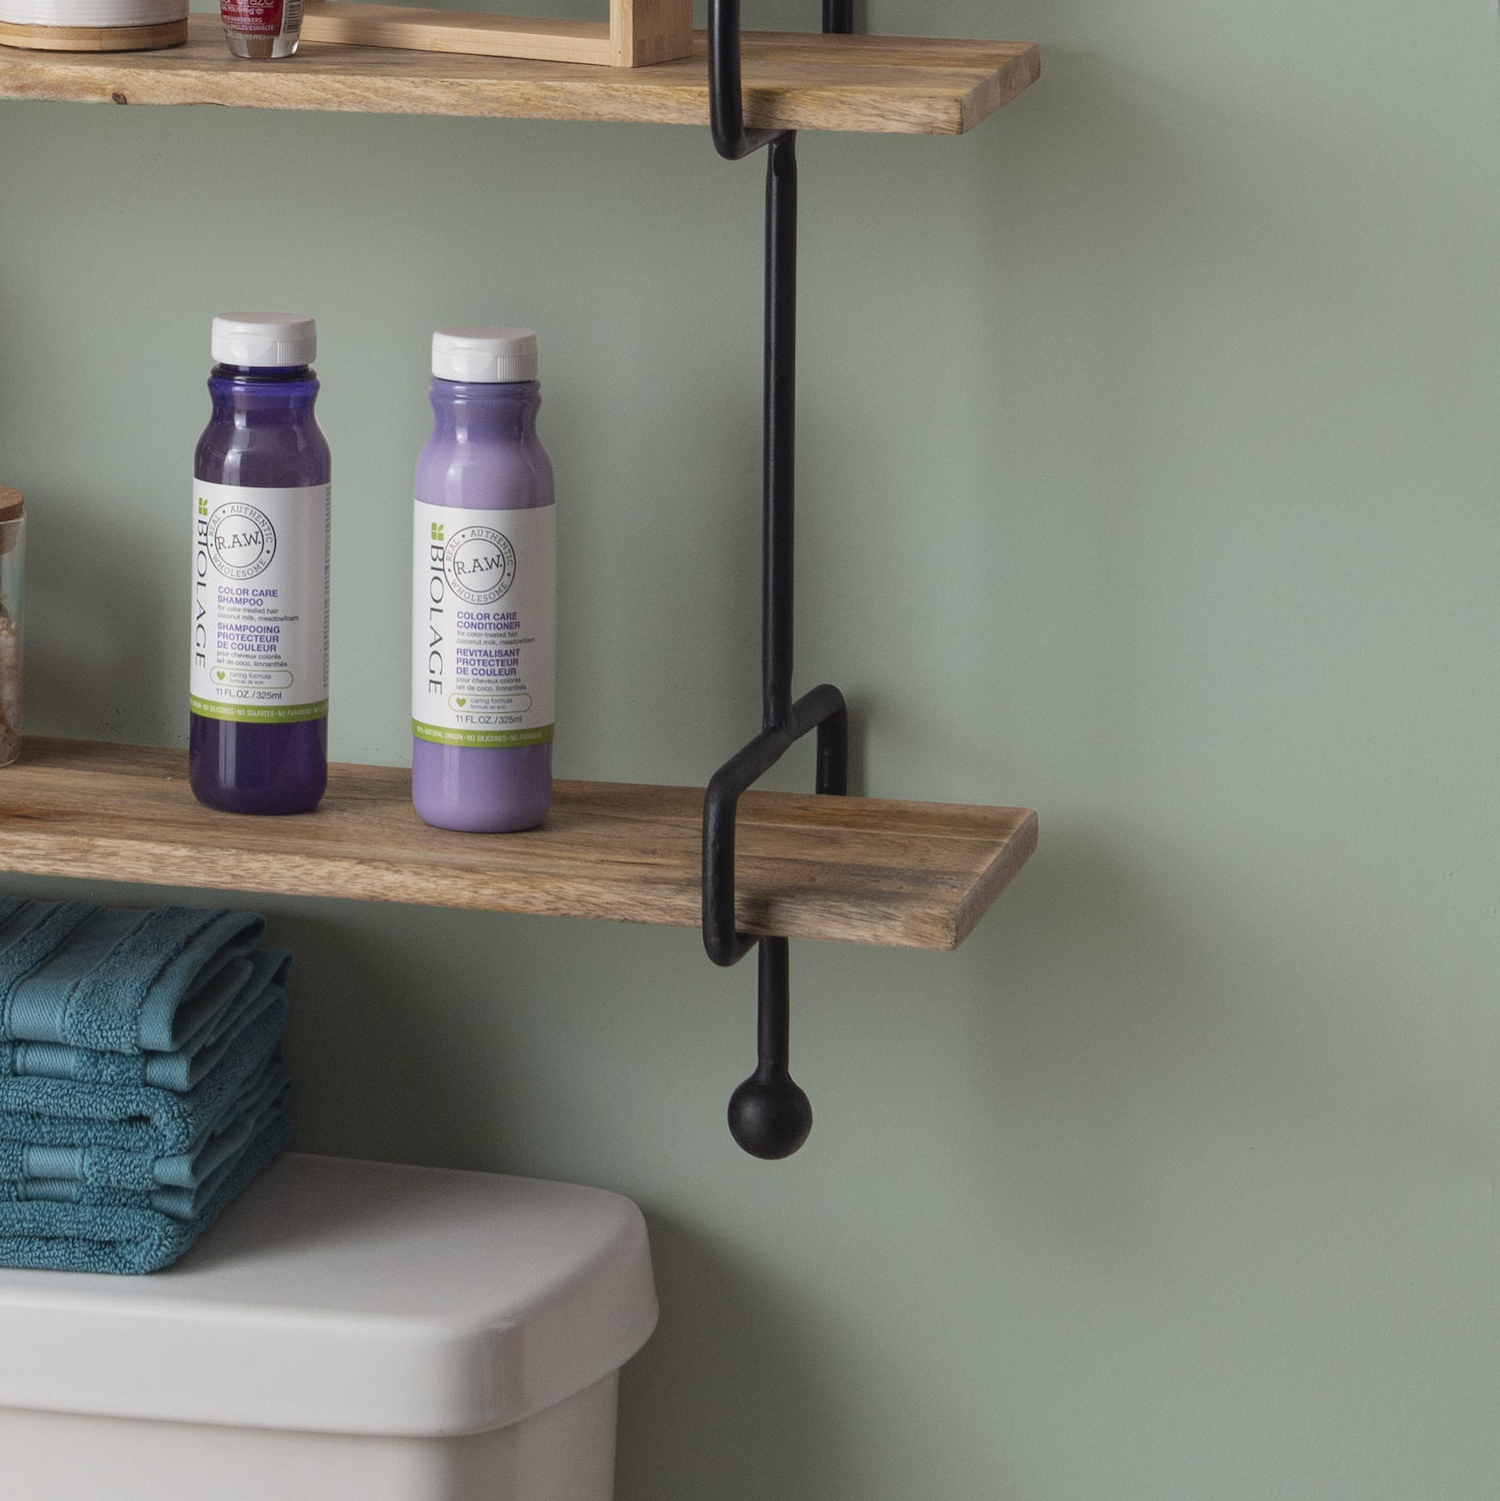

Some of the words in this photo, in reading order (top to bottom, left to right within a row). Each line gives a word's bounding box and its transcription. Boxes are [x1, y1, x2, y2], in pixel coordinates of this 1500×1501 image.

[209, 514, 221, 537] REAL
[230, 506, 273, 544] AUTHENTIC
[216, 531, 261, 550] R.A.W.
[471, 529, 513, 566] AUTHENTIC
[446, 539, 459, 562] REAL
[213, 553, 266, 577] WHOLESOME
[456, 554, 502, 574] R.A.W.
[195, 519, 208, 668] BIOLAGE
[218, 586, 249, 596] COLOR
[252, 589, 278, 597] CARE
[452, 579, 507, 602] WHOLESOME
[218, 595, 263, 606] SHAMPOO
[428, 544, 444, 695] BIOLAGE
[457, 611, 490, 620] COLOR
[493, 612, 517, 620] CARE
[218, 622, 280, 634] SHAMPOOING
[457, 621, 520, 630] CONDITIONER
[217, 632, 279, 643] PROTECTEUR
[217, 641, 228, 649] DE
[231, 642, 276, 652] COULEUR
[457, 648, 520, 658] REVITALISANT
[456, 658, 518, 667] PROTECTEUR
[456, 667, 469, 675] DE
[471, 668, 517, 676] COULEUR
